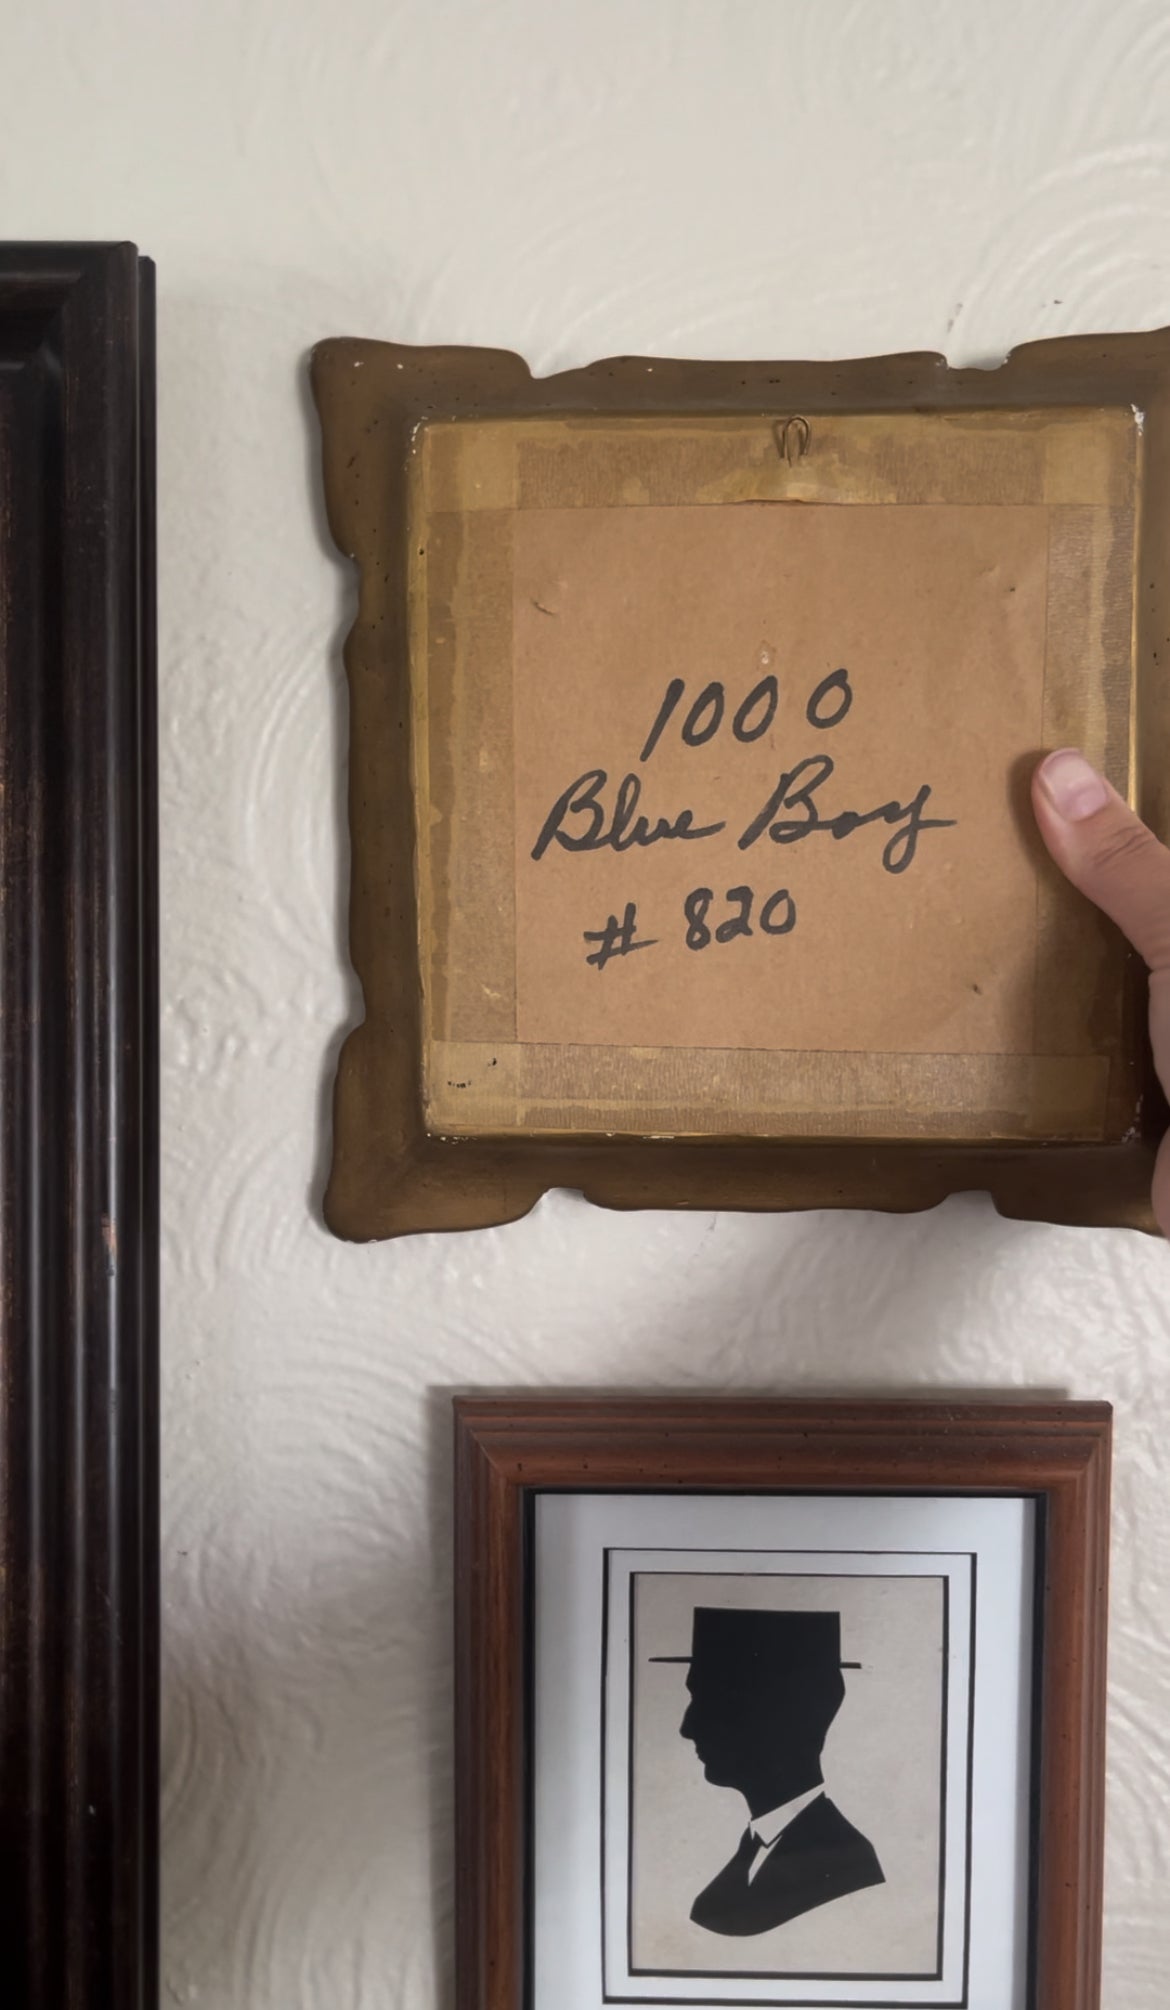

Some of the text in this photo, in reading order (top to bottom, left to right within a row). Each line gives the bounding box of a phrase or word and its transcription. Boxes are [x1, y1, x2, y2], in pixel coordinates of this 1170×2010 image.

[640, 668, 853, 762] 1000
[531, 755, 957, 874] Blue Boy
[583, 886, 797, 970] # 820
